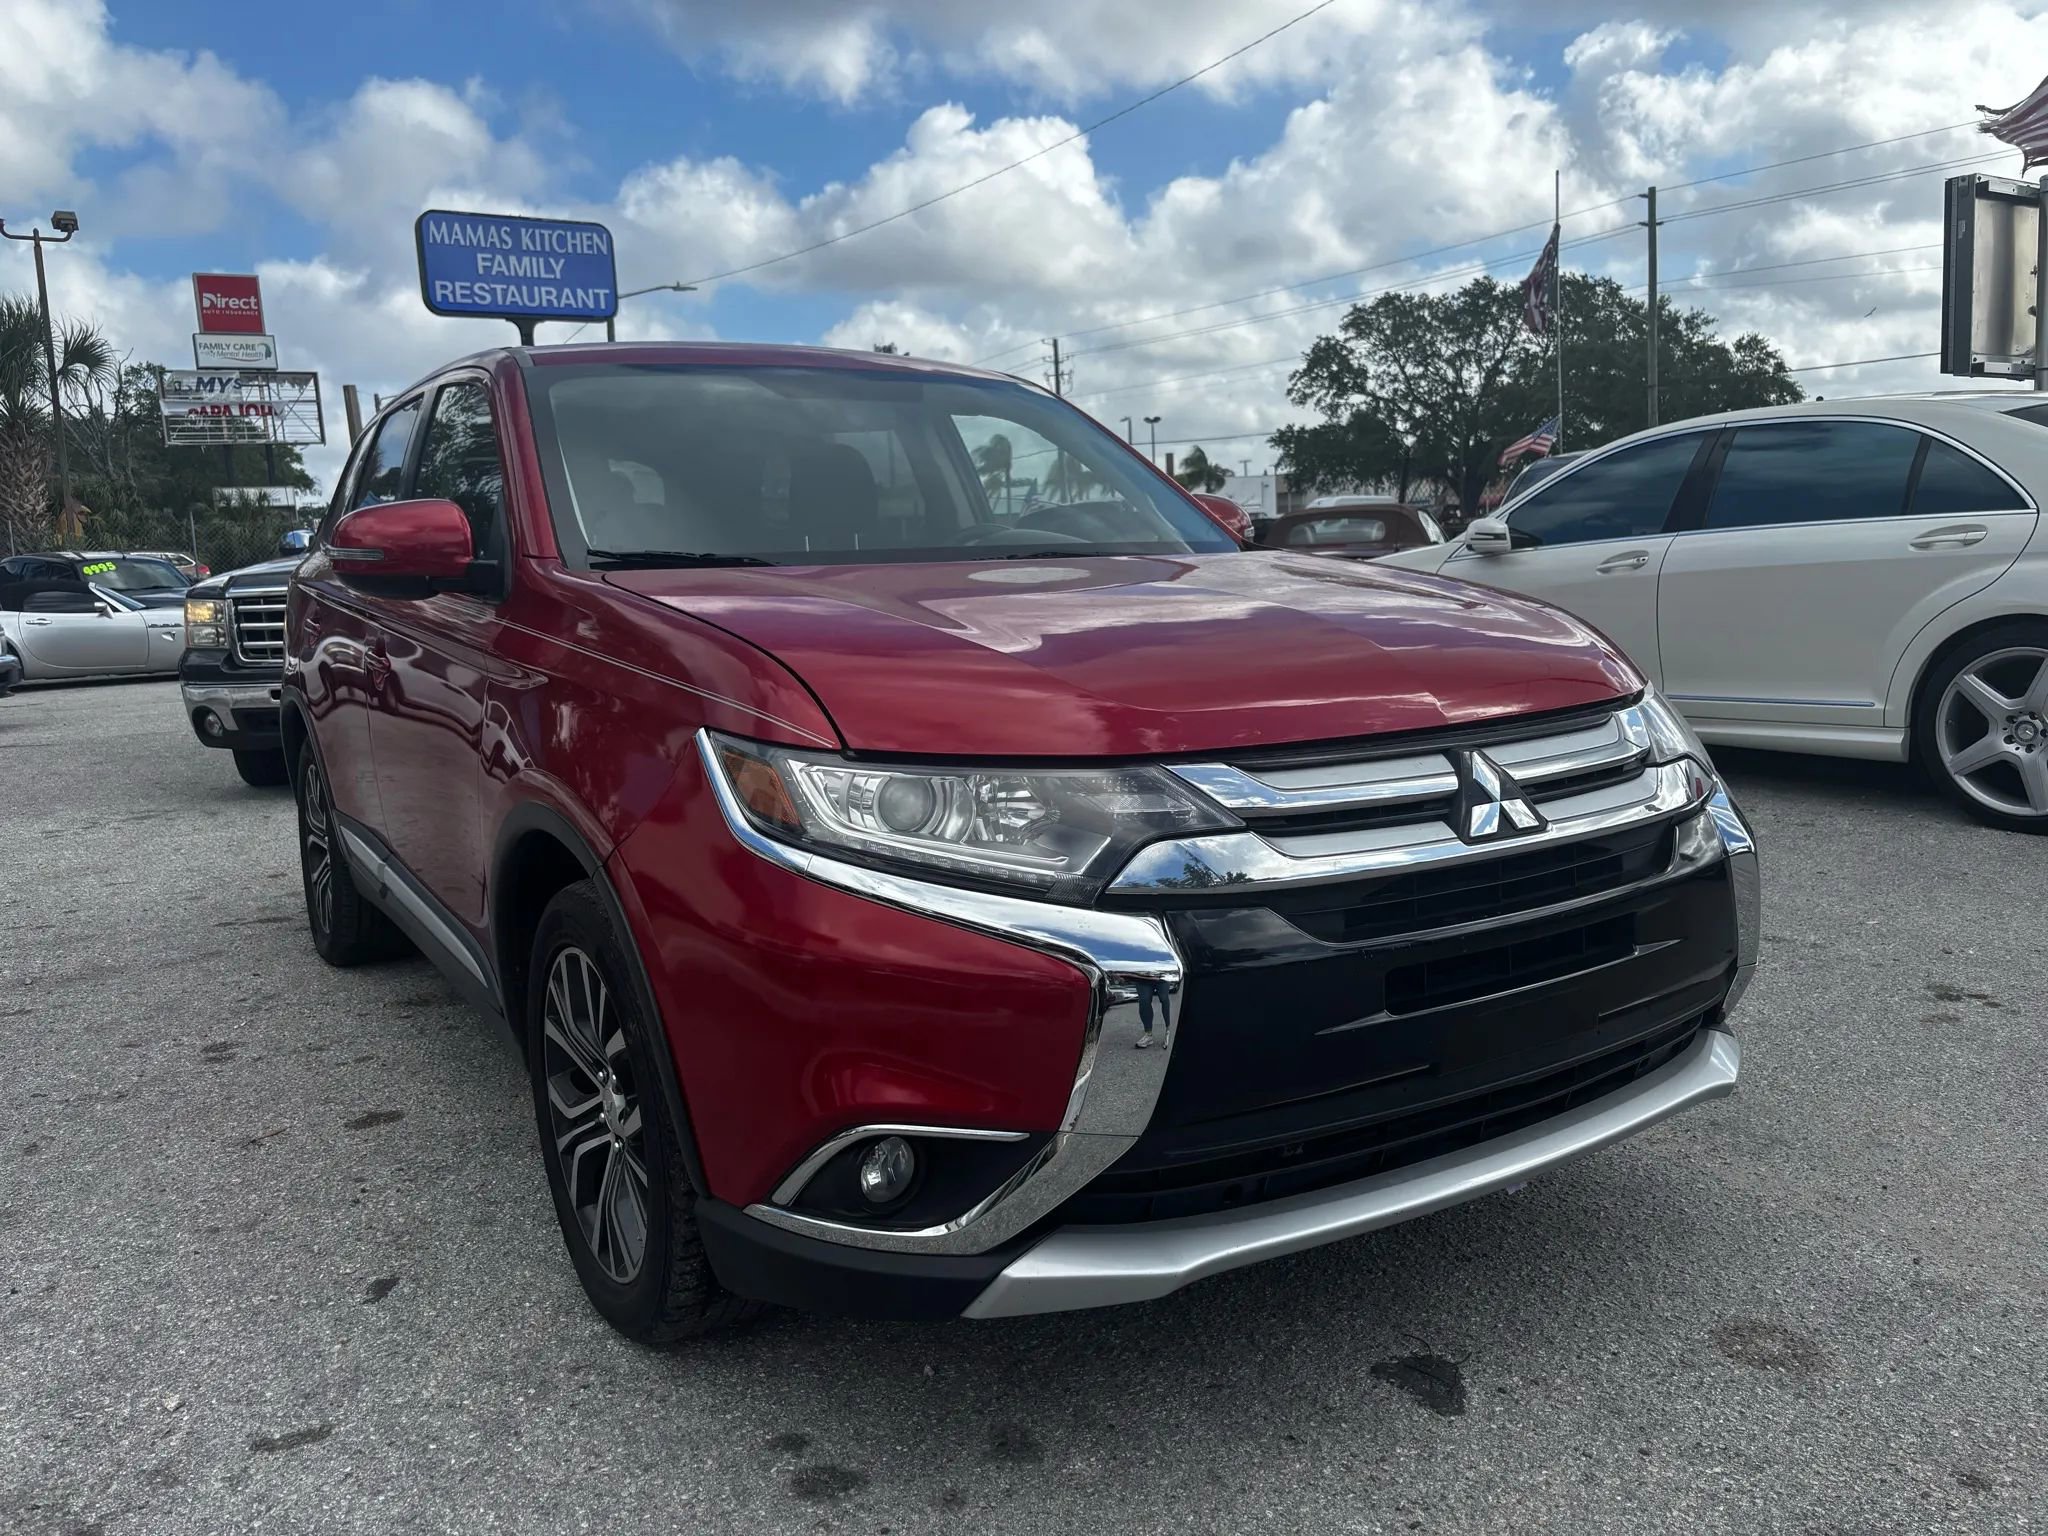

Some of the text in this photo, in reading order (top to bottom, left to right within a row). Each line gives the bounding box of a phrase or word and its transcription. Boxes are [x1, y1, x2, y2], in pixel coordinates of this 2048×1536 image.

[428, 219, 608, 256] MAMAS KITCHEN
[476, 252, 566, 280] FAMILY
[202, 292, 259, 309] Direct
[434, 279, 610, 310] RESTAURANT
[198, 342, 257, 352] FAMILY CARE
